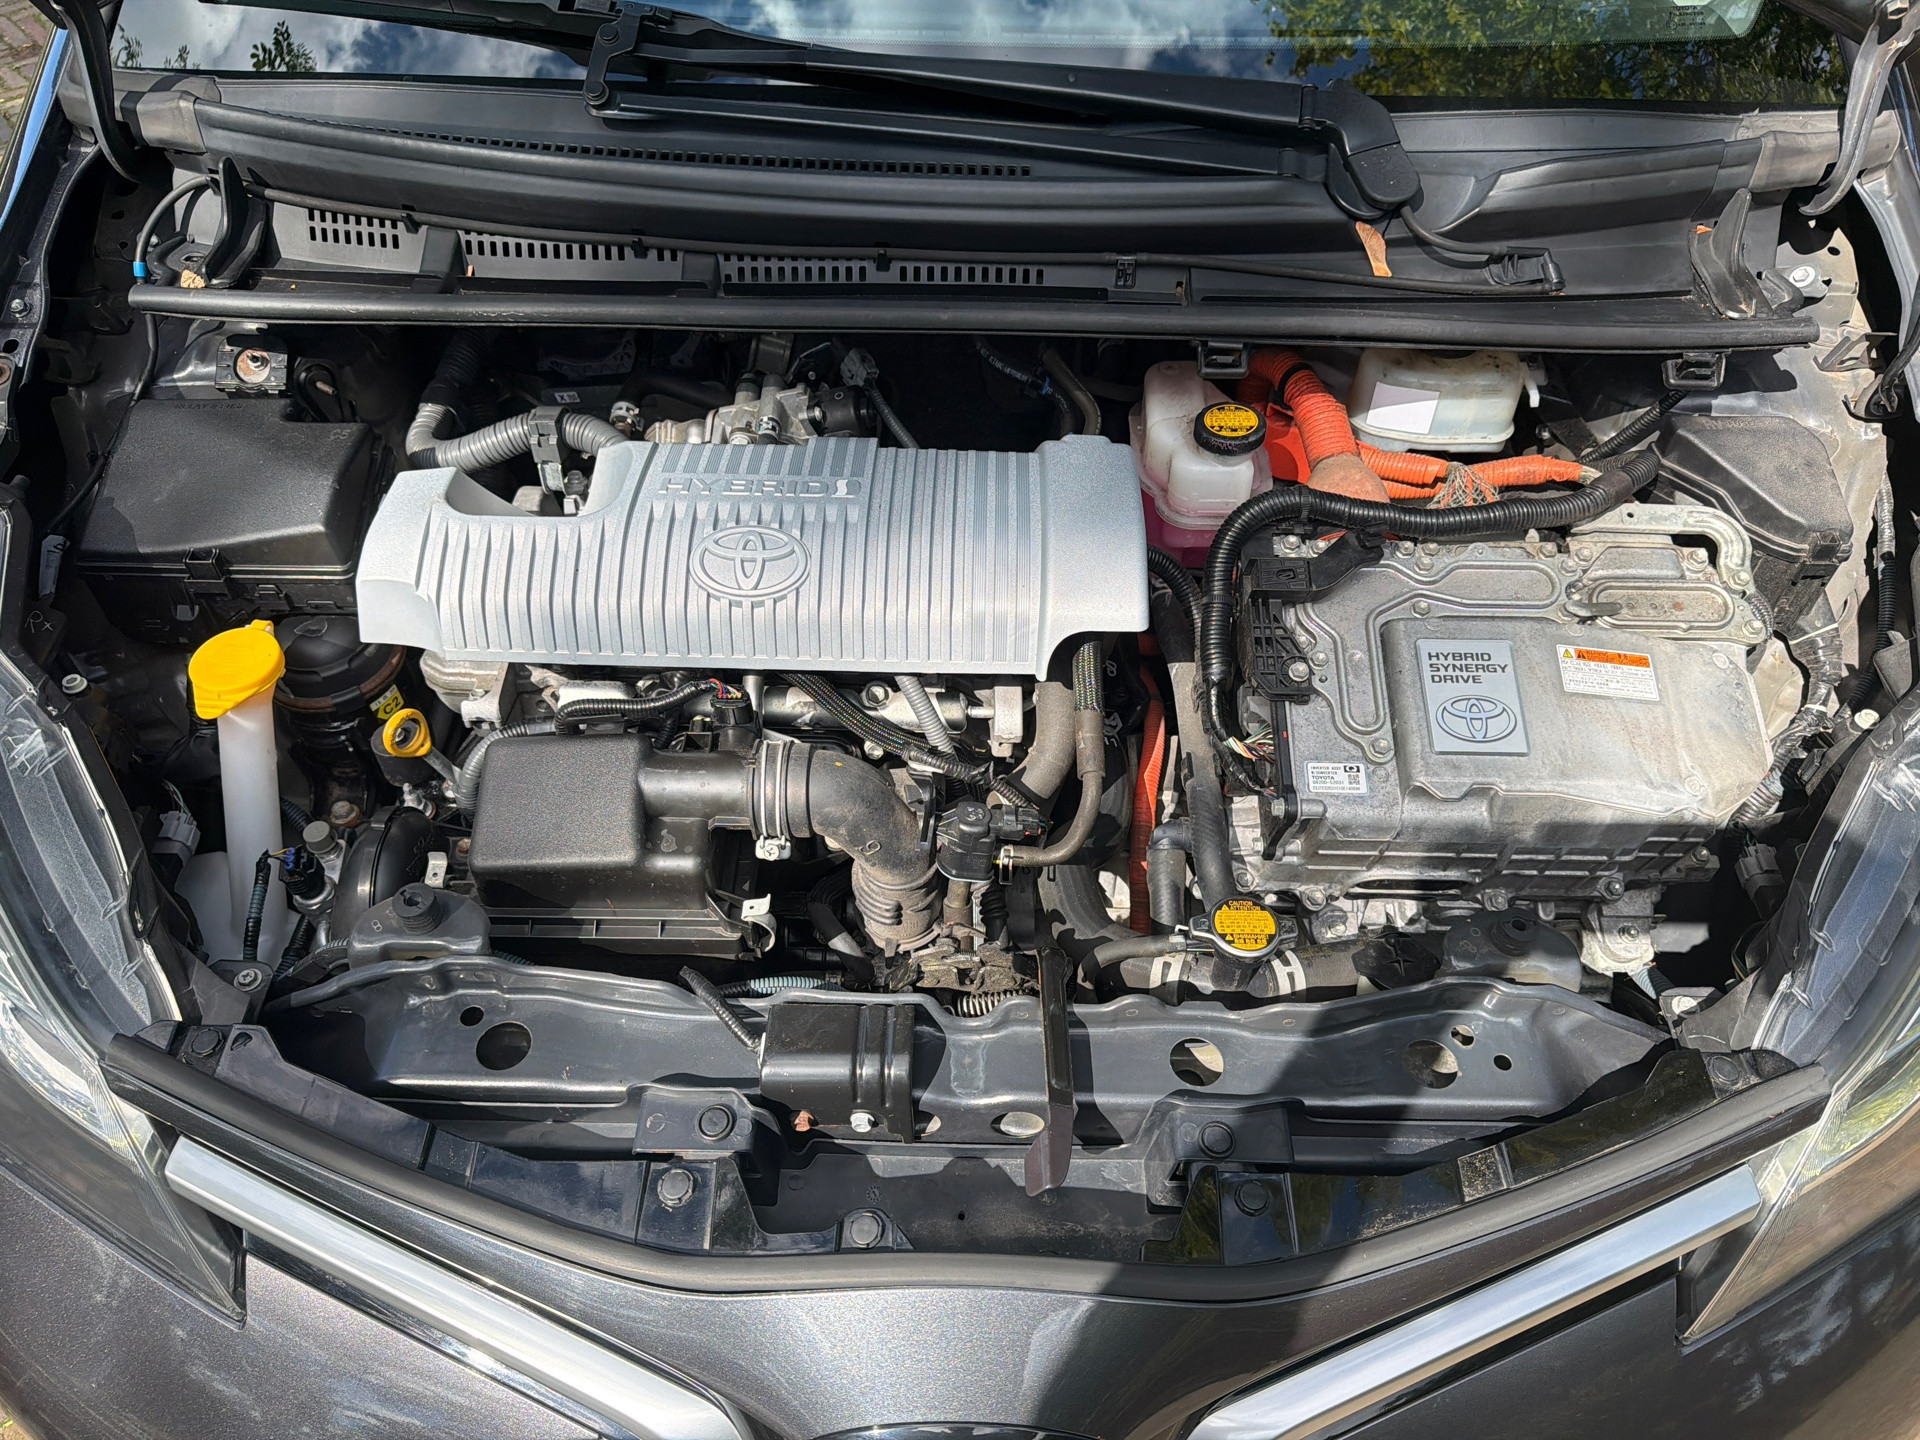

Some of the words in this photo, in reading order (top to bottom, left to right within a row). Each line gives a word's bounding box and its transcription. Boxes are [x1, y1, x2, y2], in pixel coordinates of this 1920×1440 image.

[657, 477, 828, 497] HYBRID
[1427, 652, 1492, 661] HYBRID
[1429, 663, 1508, 673] SYNERGY
[1430, 674, 1483, 684] DRIVE
